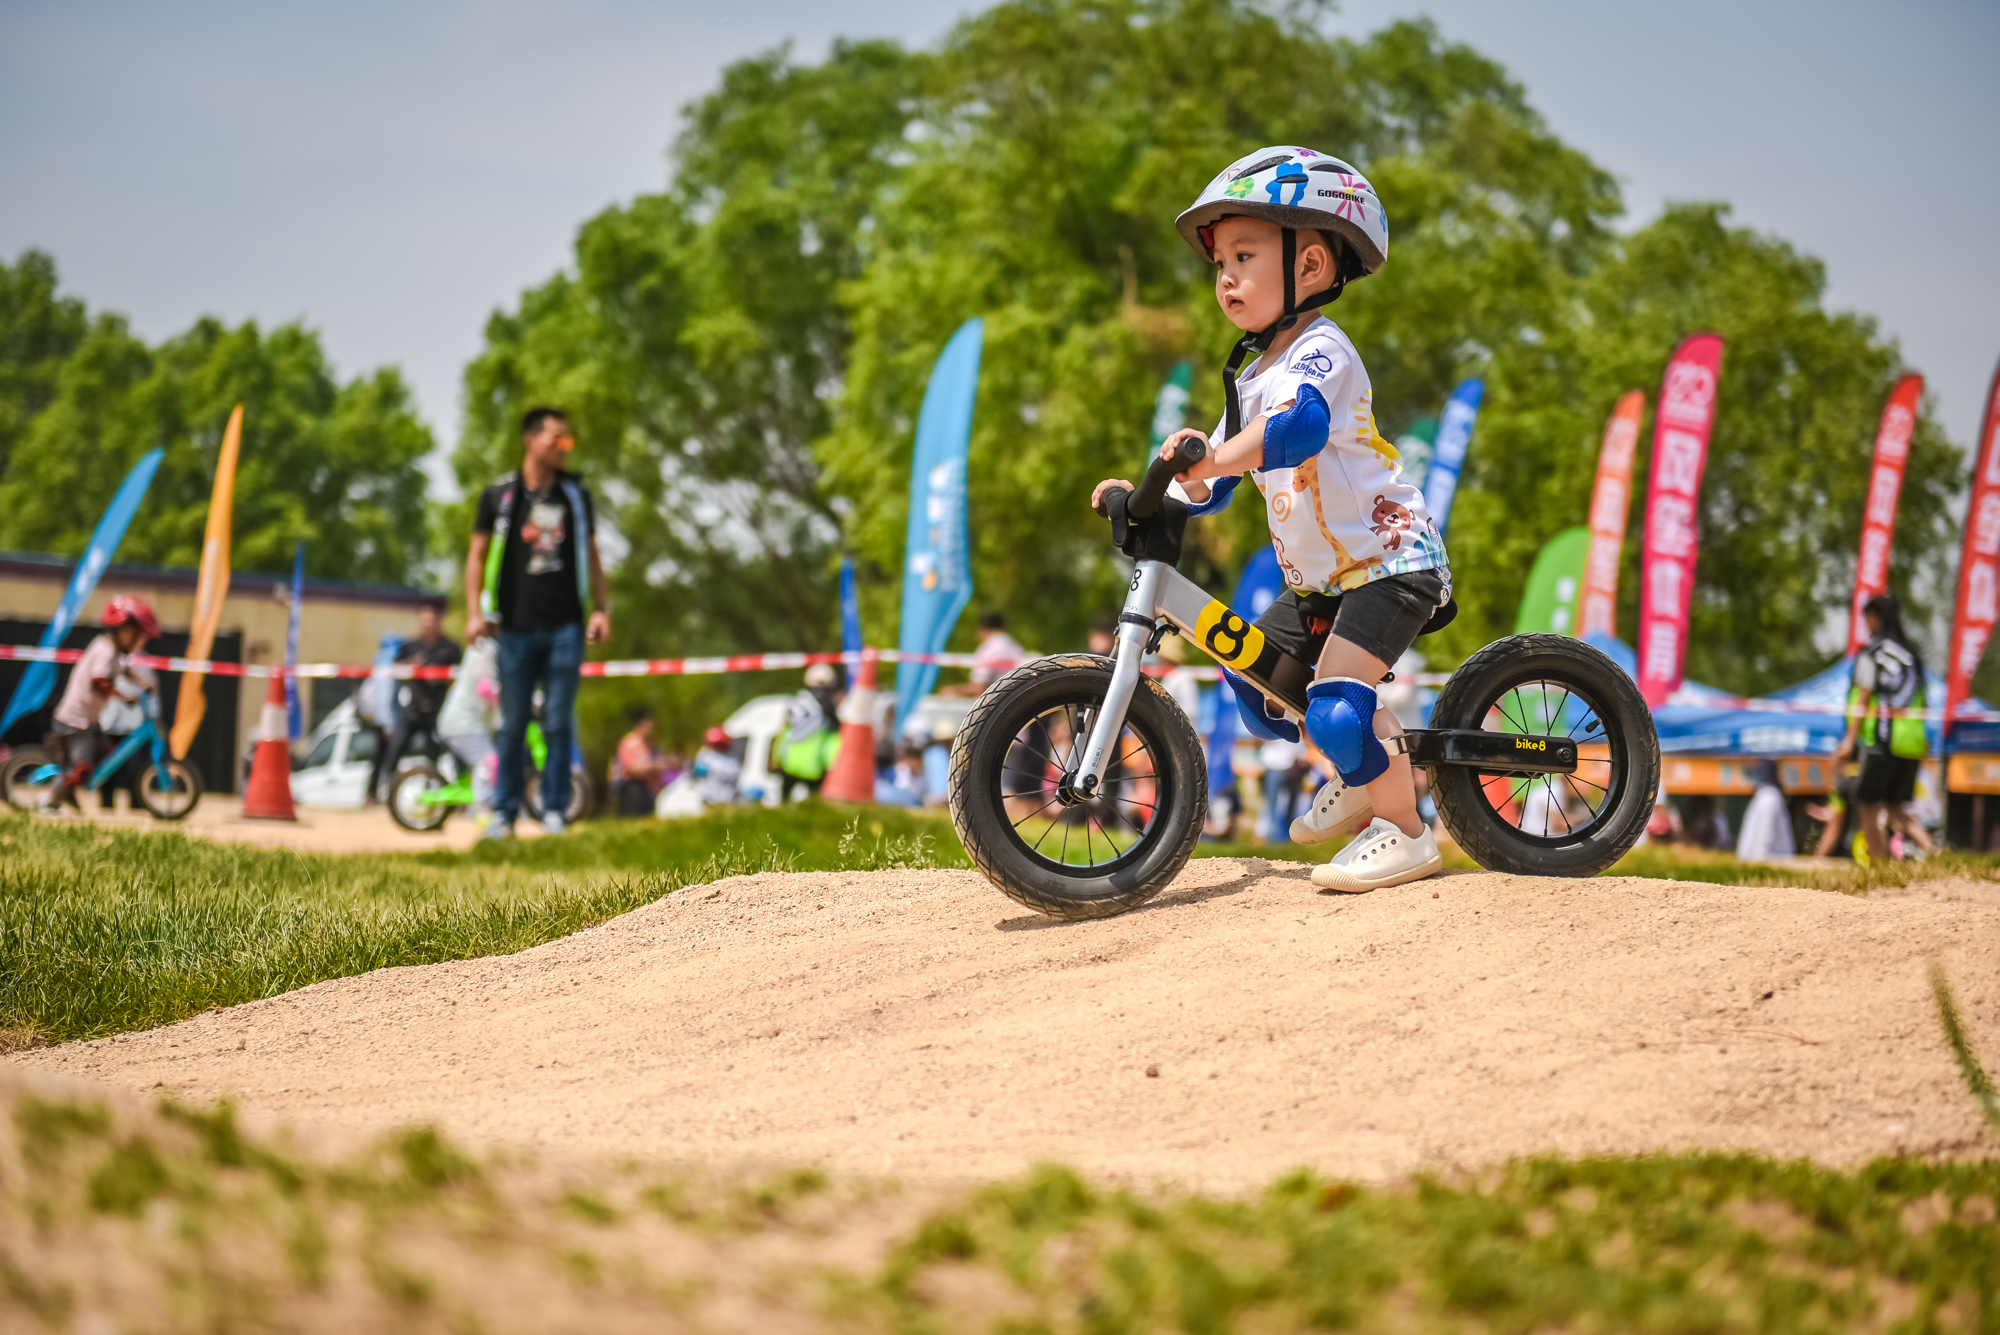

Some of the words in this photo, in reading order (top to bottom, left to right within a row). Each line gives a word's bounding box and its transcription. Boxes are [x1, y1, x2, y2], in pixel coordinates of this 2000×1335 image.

[1317, 189, 1365, 205] GOGOBIKE
[1130, 568, 1142, 591] 8
[1205, 609, 1250, 662] 8
[1515, 738, 1546, 751] bike8
